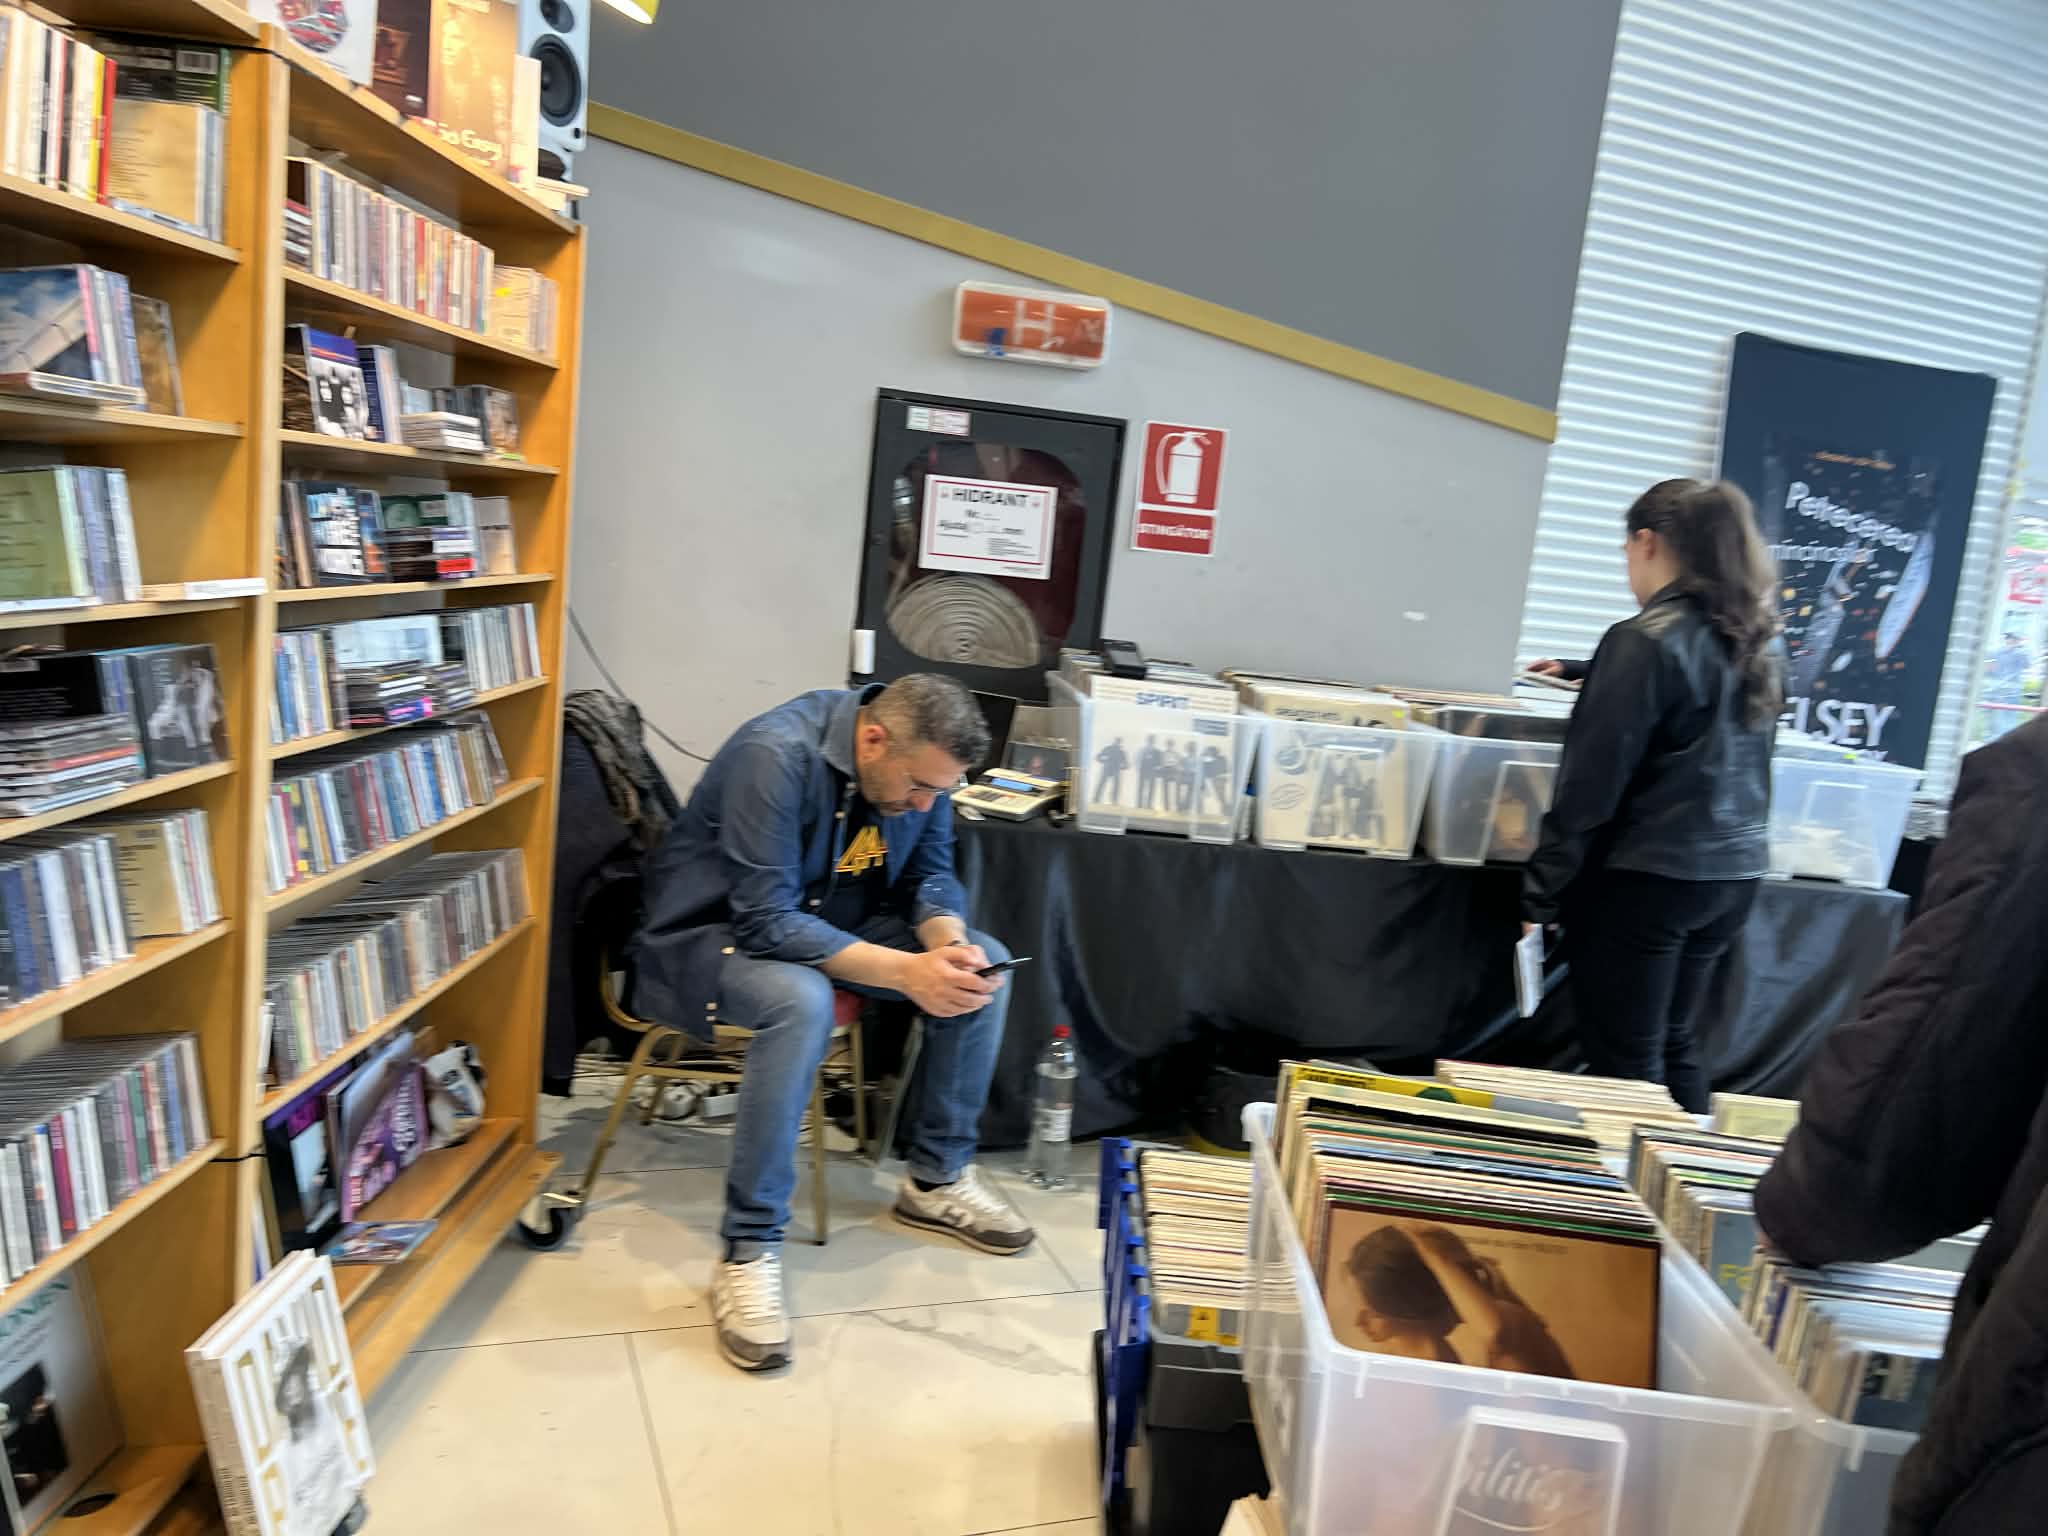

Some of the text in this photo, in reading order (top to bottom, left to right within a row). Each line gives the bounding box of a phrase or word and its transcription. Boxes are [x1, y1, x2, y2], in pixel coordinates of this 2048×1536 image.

[1014, 299, 1056, 346] H
[951, 487, 1030, 507] HIDRANT
[1135, 692, 1190, 709] SPIRIT
